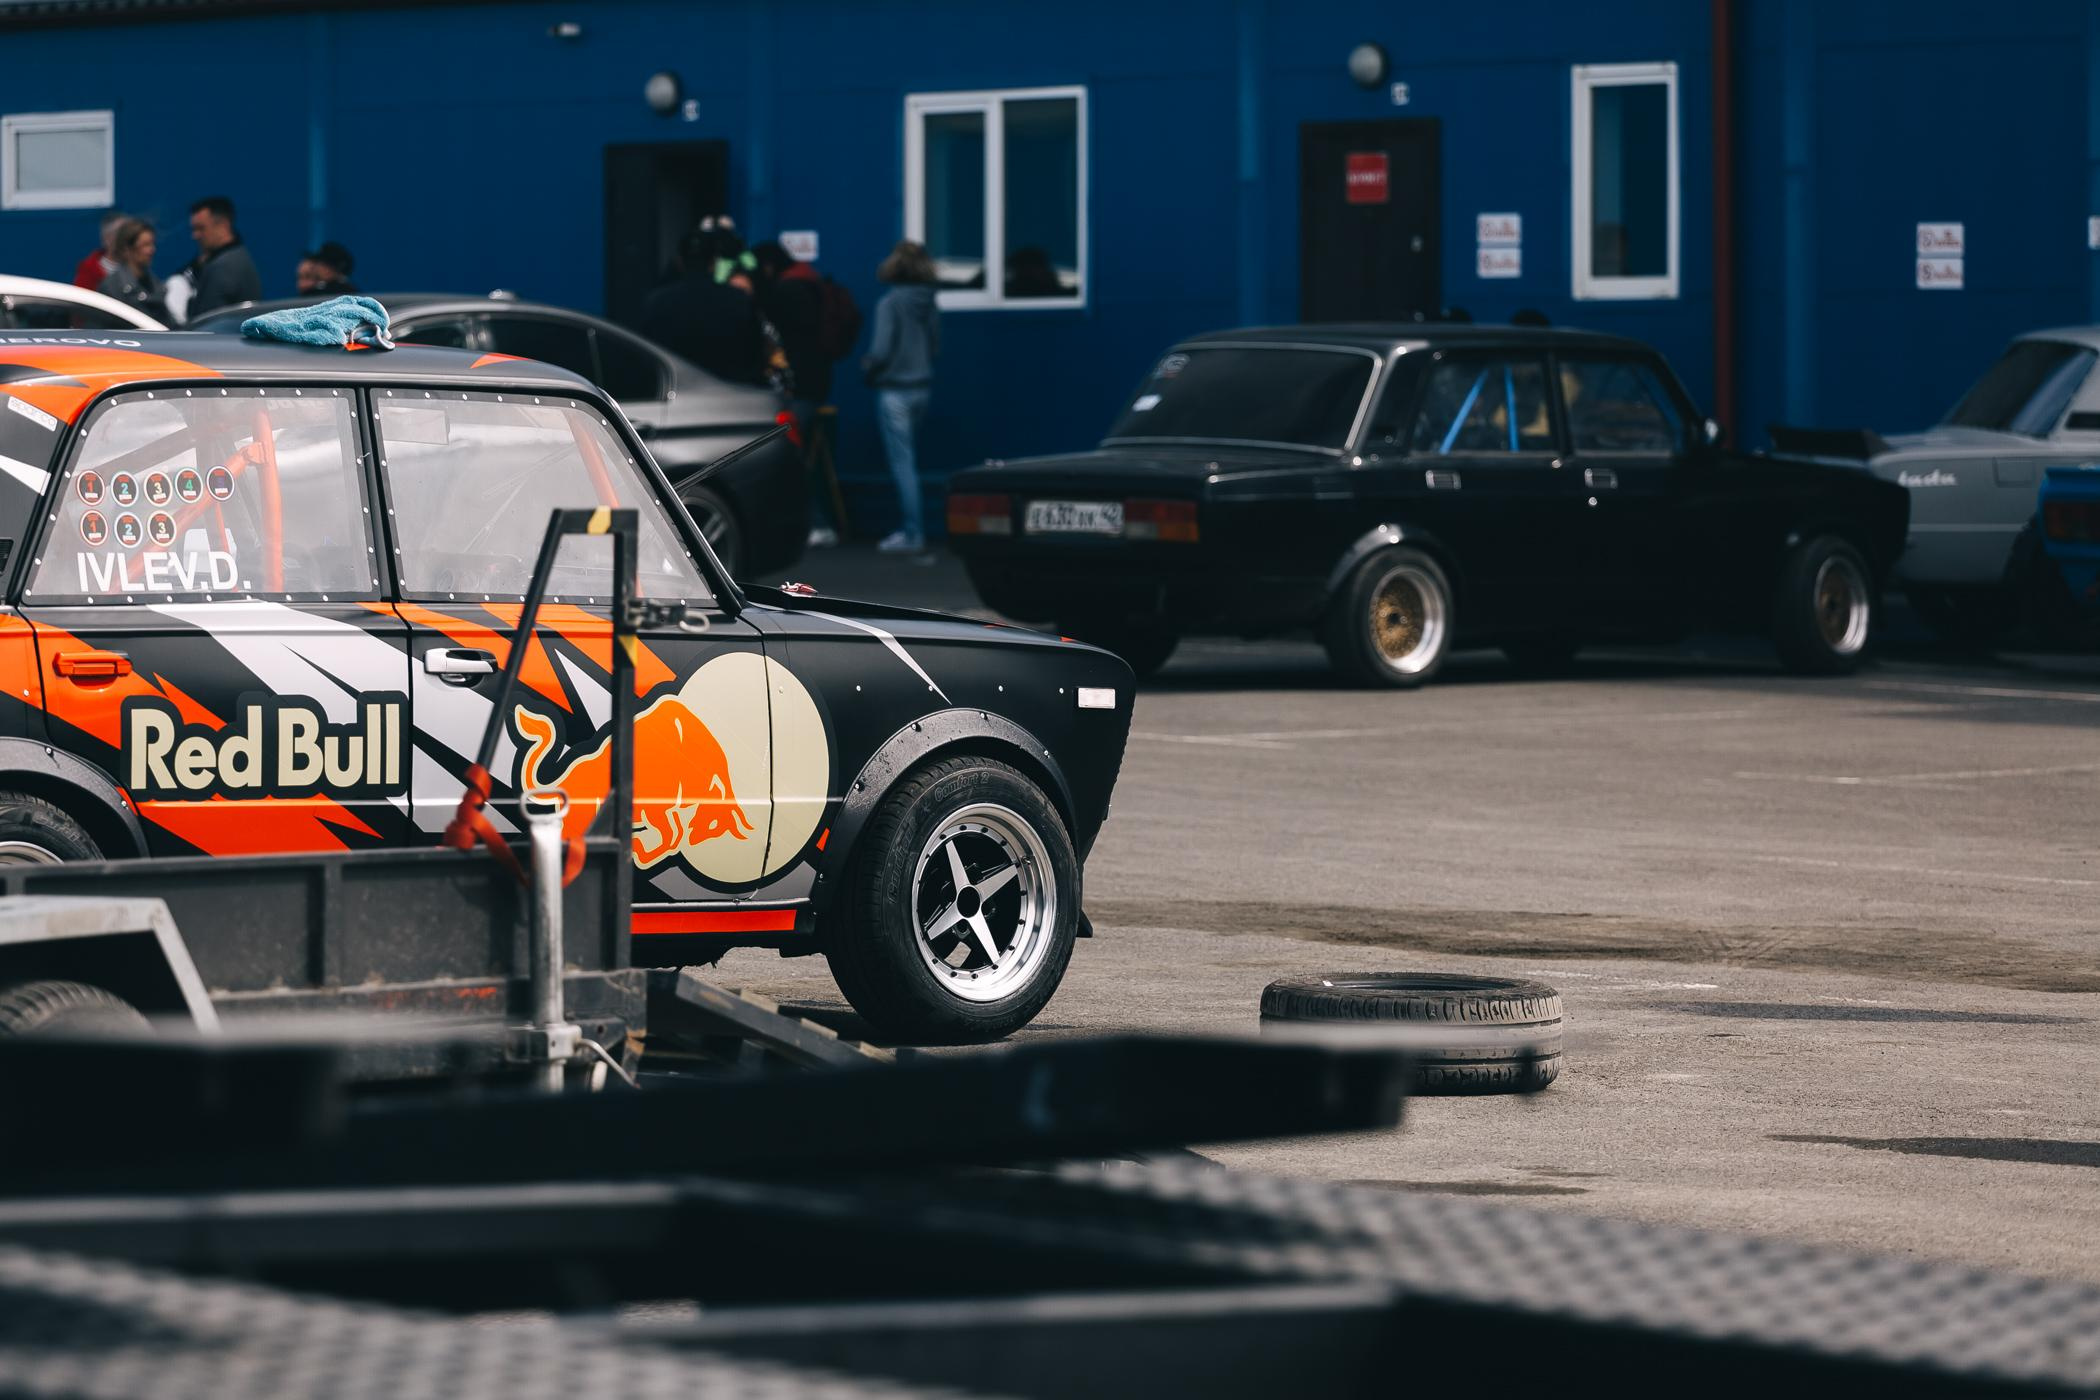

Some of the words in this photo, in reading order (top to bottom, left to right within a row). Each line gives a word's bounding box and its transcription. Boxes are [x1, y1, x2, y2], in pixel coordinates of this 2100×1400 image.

[121, 483, 129, 495] 2
[154, 482, 163, 494] 3
[186, 479, 194, 491] 4
[125, 524, 133, 536] 2
[158, 522, 166, 533] 3
[131, 705, 262, 790] Red
[278, 703, 400, 787] Bull
